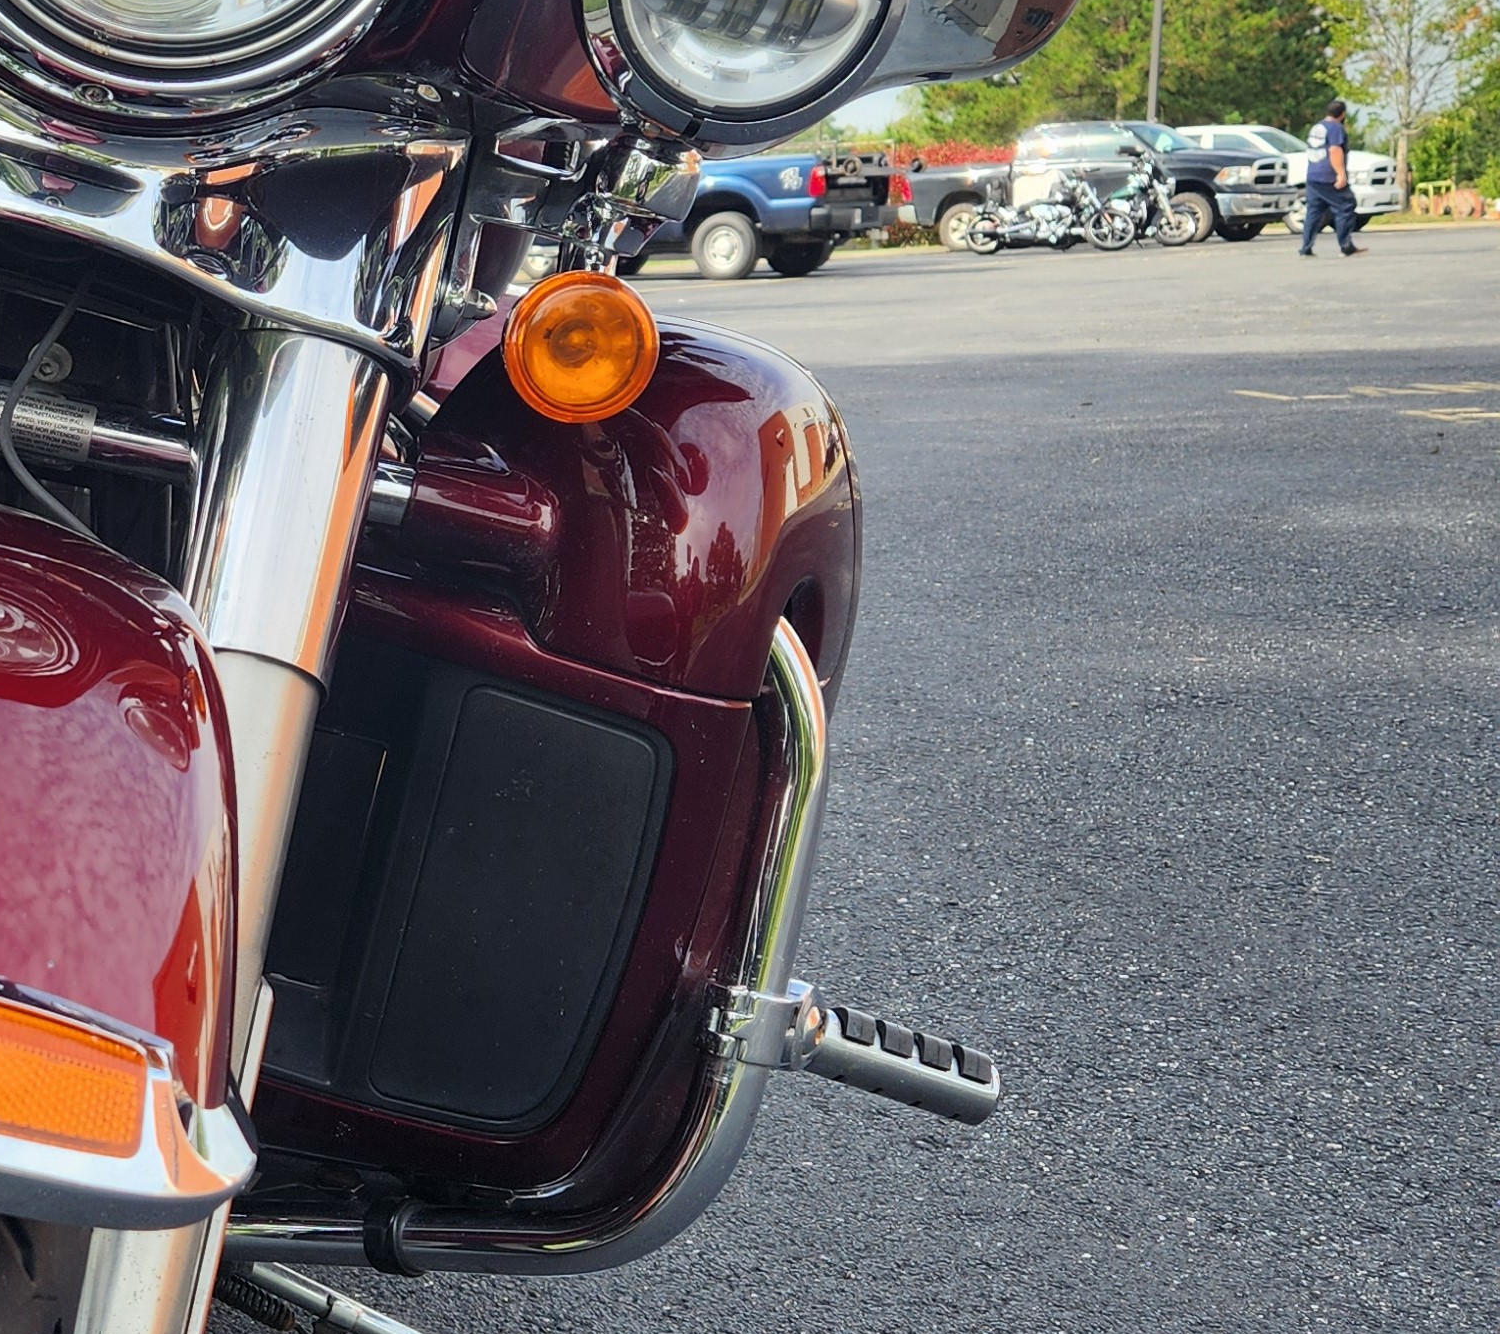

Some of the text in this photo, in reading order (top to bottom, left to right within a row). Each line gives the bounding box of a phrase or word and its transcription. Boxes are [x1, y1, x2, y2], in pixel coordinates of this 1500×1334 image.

[44, 405, 83, 418] PROTECTION
[16, 421, 34, 430] MADE
[34, 425, 48, 433] NOR
[49, 428, 81, 440] INTENDED
[36, 419, 52, 427] VERY
[54, 422, 68, 430] LOW
[41, 434, 60, 442] FROM
[61, 439, 83, 447] BODILY
